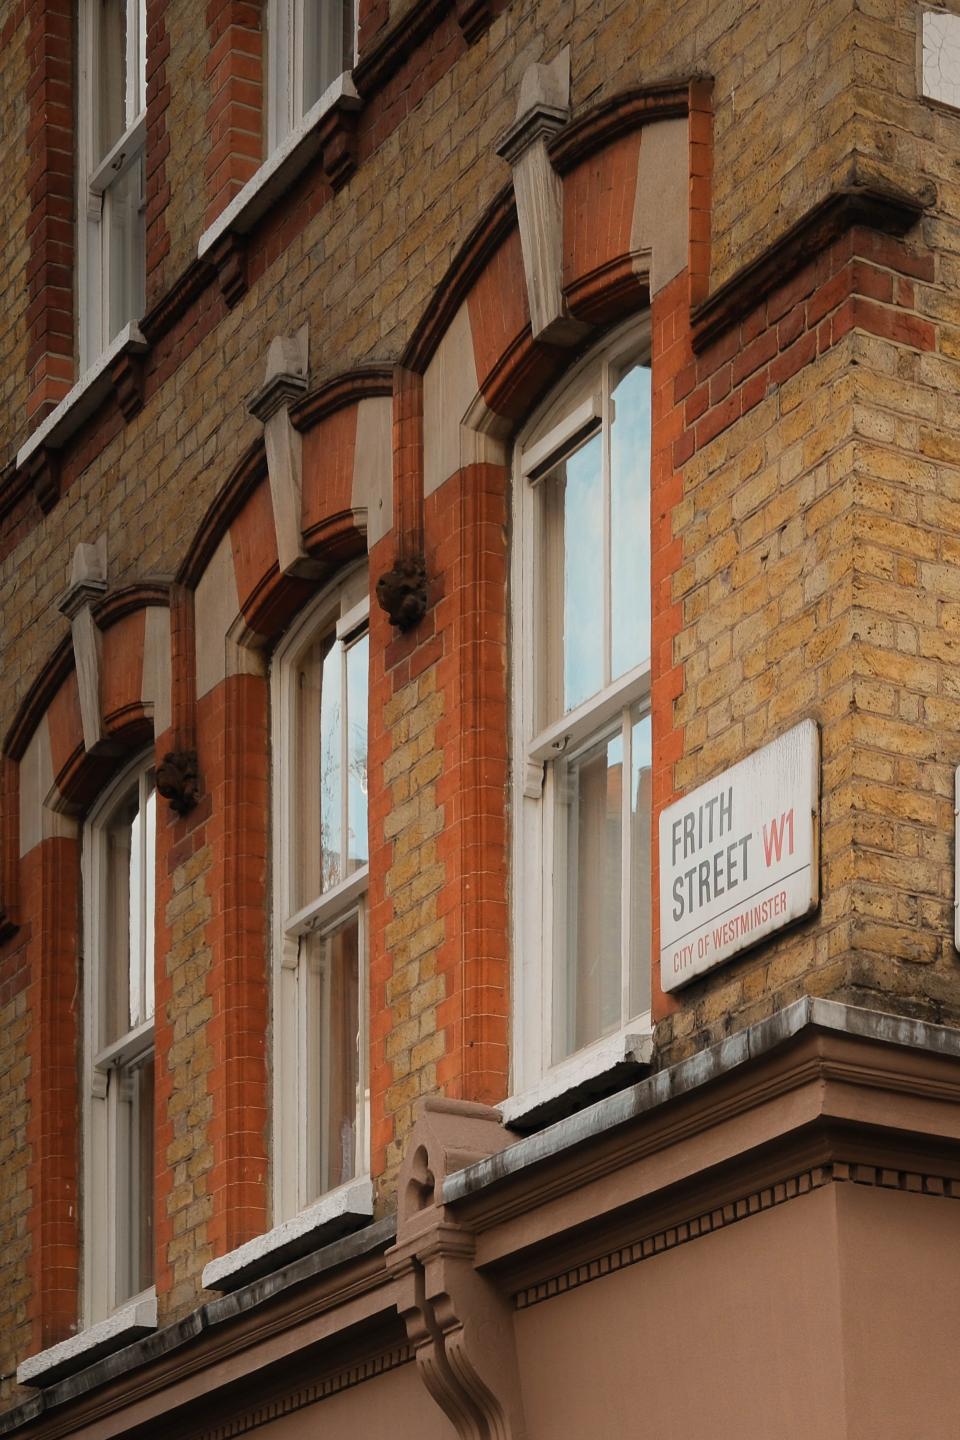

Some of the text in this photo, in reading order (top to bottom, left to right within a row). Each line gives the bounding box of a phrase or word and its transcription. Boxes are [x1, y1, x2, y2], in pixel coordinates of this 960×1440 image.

[672, 786, 733, 867] FRITH
[672, 808, 794, 922] STREET W1
[673, 891, 787, 973] CITY OF WESTMINSTER
